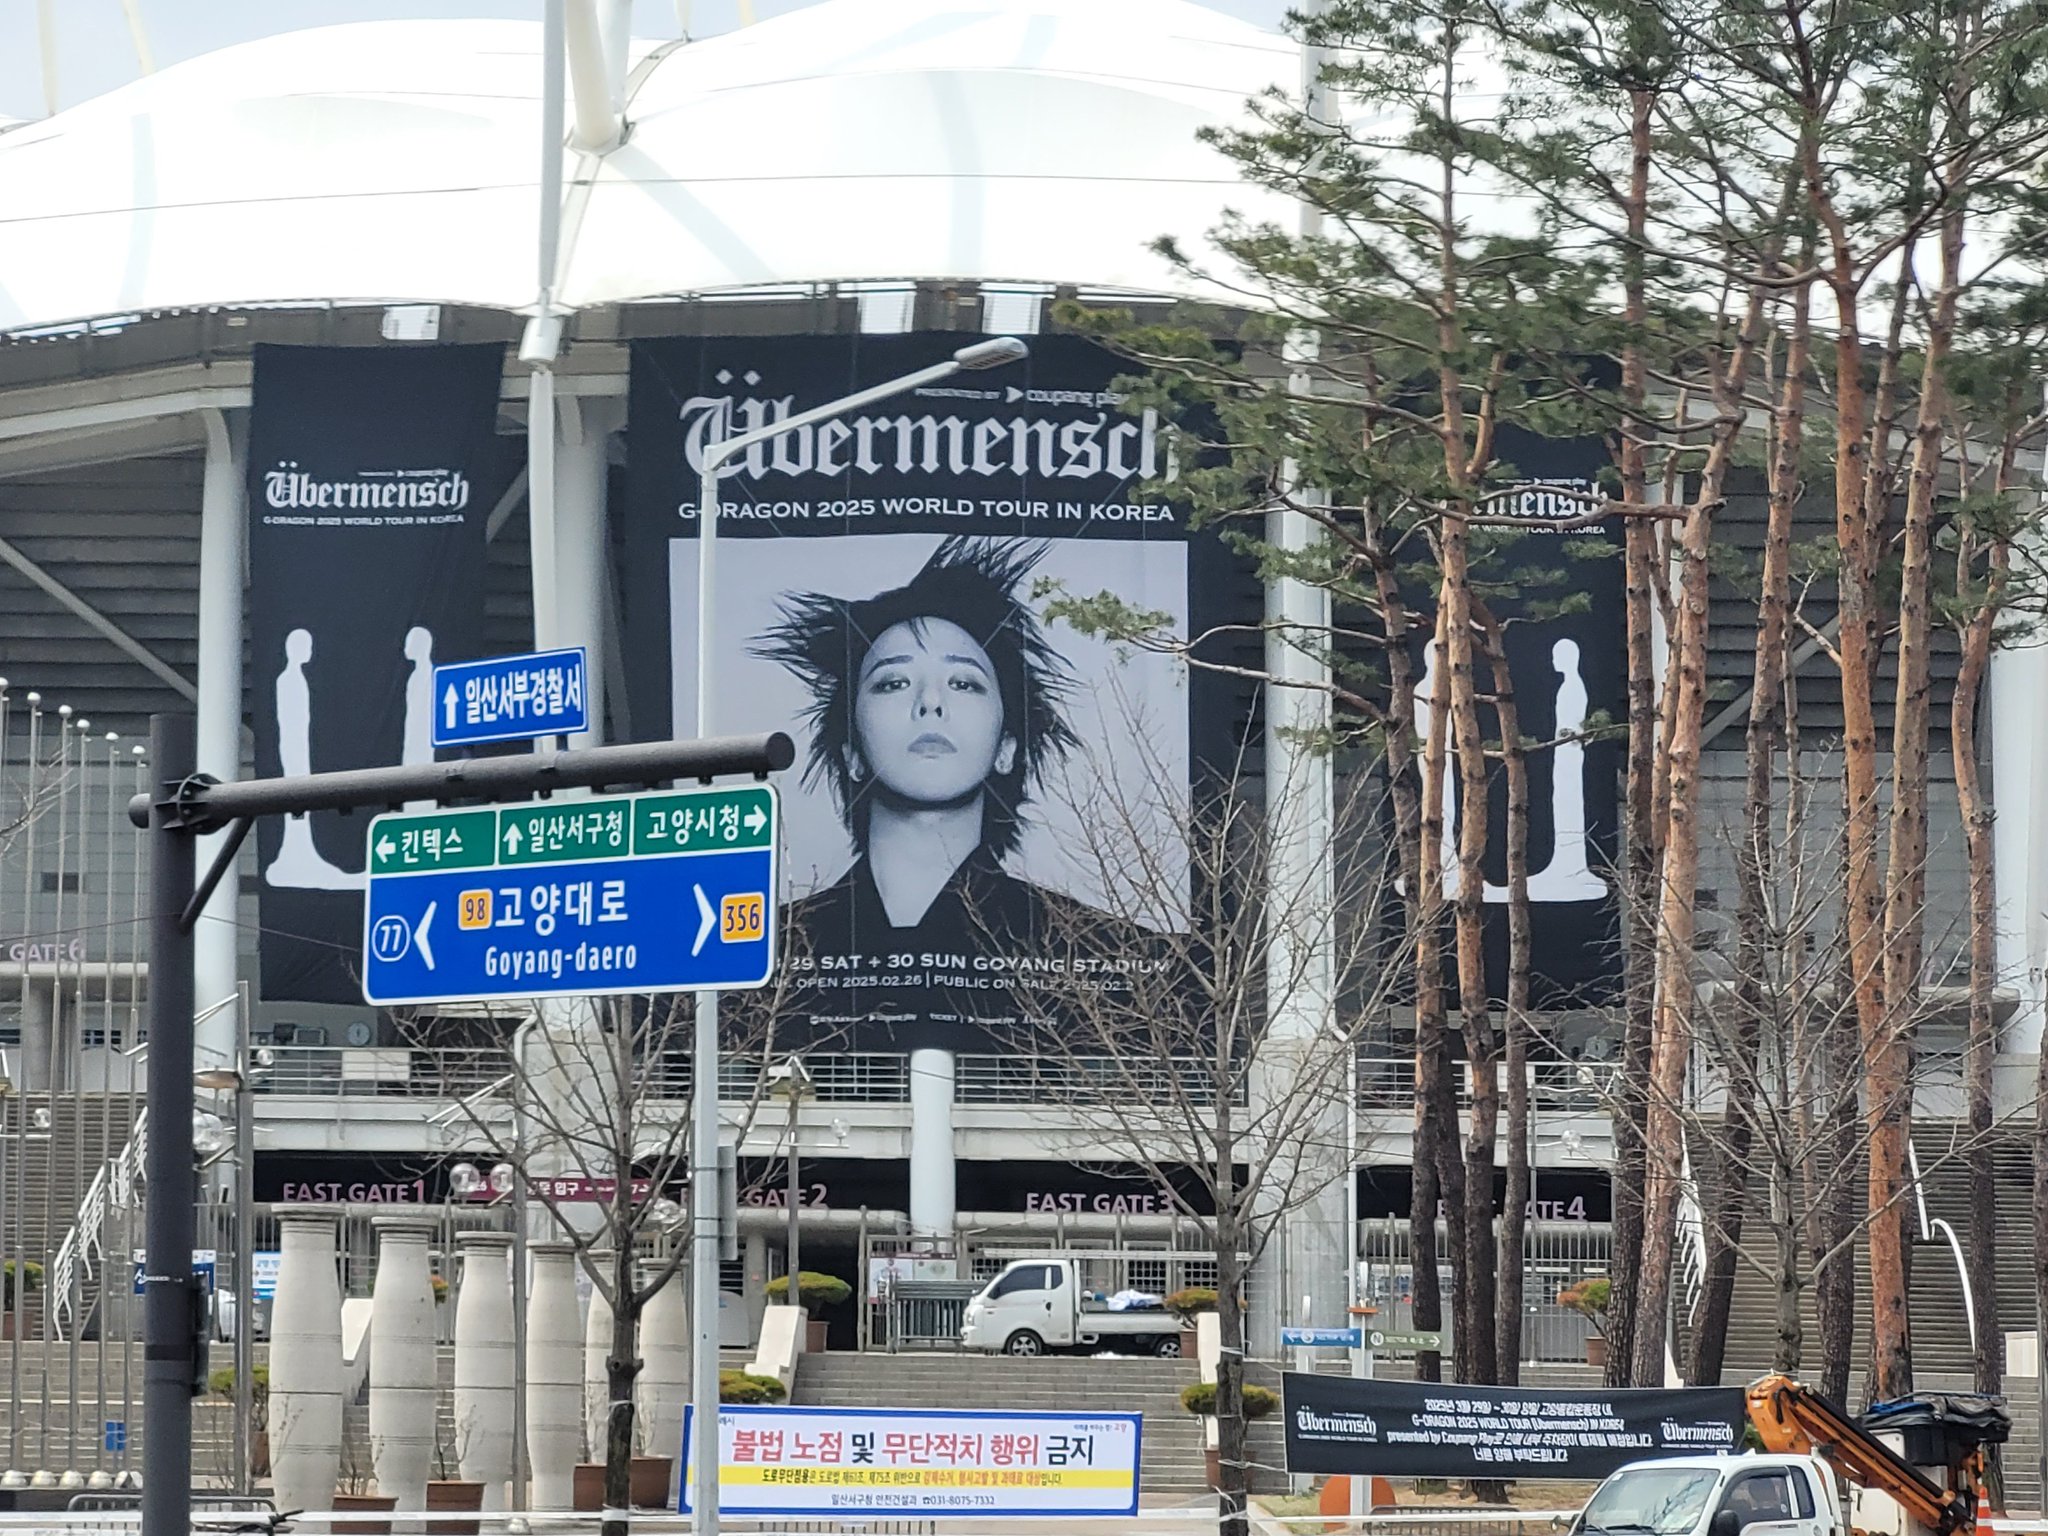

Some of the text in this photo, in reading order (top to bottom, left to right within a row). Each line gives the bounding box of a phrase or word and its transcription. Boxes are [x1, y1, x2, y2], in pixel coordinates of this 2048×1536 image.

[264, 461, 470, 511] Übermensch
[344, 517, 383, 525] WORLD
[385, 517, 414, 525] TOUR
[416, 516, 428, 524] IN
[430, 514, 464, 524] KOREA
[817, 499, 875, 517] 2025
[882, 498, 975, 515] WORLD
[980, 501, 1049, 518] TOUR
[1057, 503, 1082, 519] IN
[1090, 504, 1175, 521] KOREA
[465, 663, 582, 724] 일산서부경찰서
[528, 809, 624, 854] 일산서구청
[645, 803, 740, 846] 고양시청
[401, 826, 464, 864] 킨텍스
[465, 879, 629, 937] 98 고양대로
[725, 902, 760, 932] 356
[380, 924, 404, 953] 77
[485, 943, 637, 980] Goyang-daero
[821, 955, 863, 971] SAT
[868, 956, 881, 969] +
[887, 953, 914, 969] 30
[920, 953, 967, 969] SUN
[973, 955, 1065, 974] GOYANG
[797, 977, 838, 989] OPEN
[842, 974, 922, 989] 2025.02.26
[934, 974, 989, 990] PUBLIC
[993, 978, 1016, 989] ON
[283, 1182, 342, 1202] EAST
[554, 1181, 579, 1197] 입구
[1026, 1192, 1087, 1214] EAST
[1424, 1398, 1455, 1413] 2025년
[1296, 1405, 1377, 1436] Übermensch
[1411, 1413, 1457, 1428] G-DRAGON
[1456, 1416, 1478, 1429] 2025
[1477, 1417, 1509, 1430] WORLD
[1508, 1418, 1532, 1430] TOUR
[1661, 1416, 1734, 1443] Übermensch
[732, 1429, 1094, 1466] 불법 노점 및 무단적치 행위 금지
[1386, 1430, 1430, 1444] presented
[893, 1471, 921, 1485] 위반으로
[831, 1493, 873, 1506] 일산서구청
[875, 1494, 917, 1507] 안전건설과
